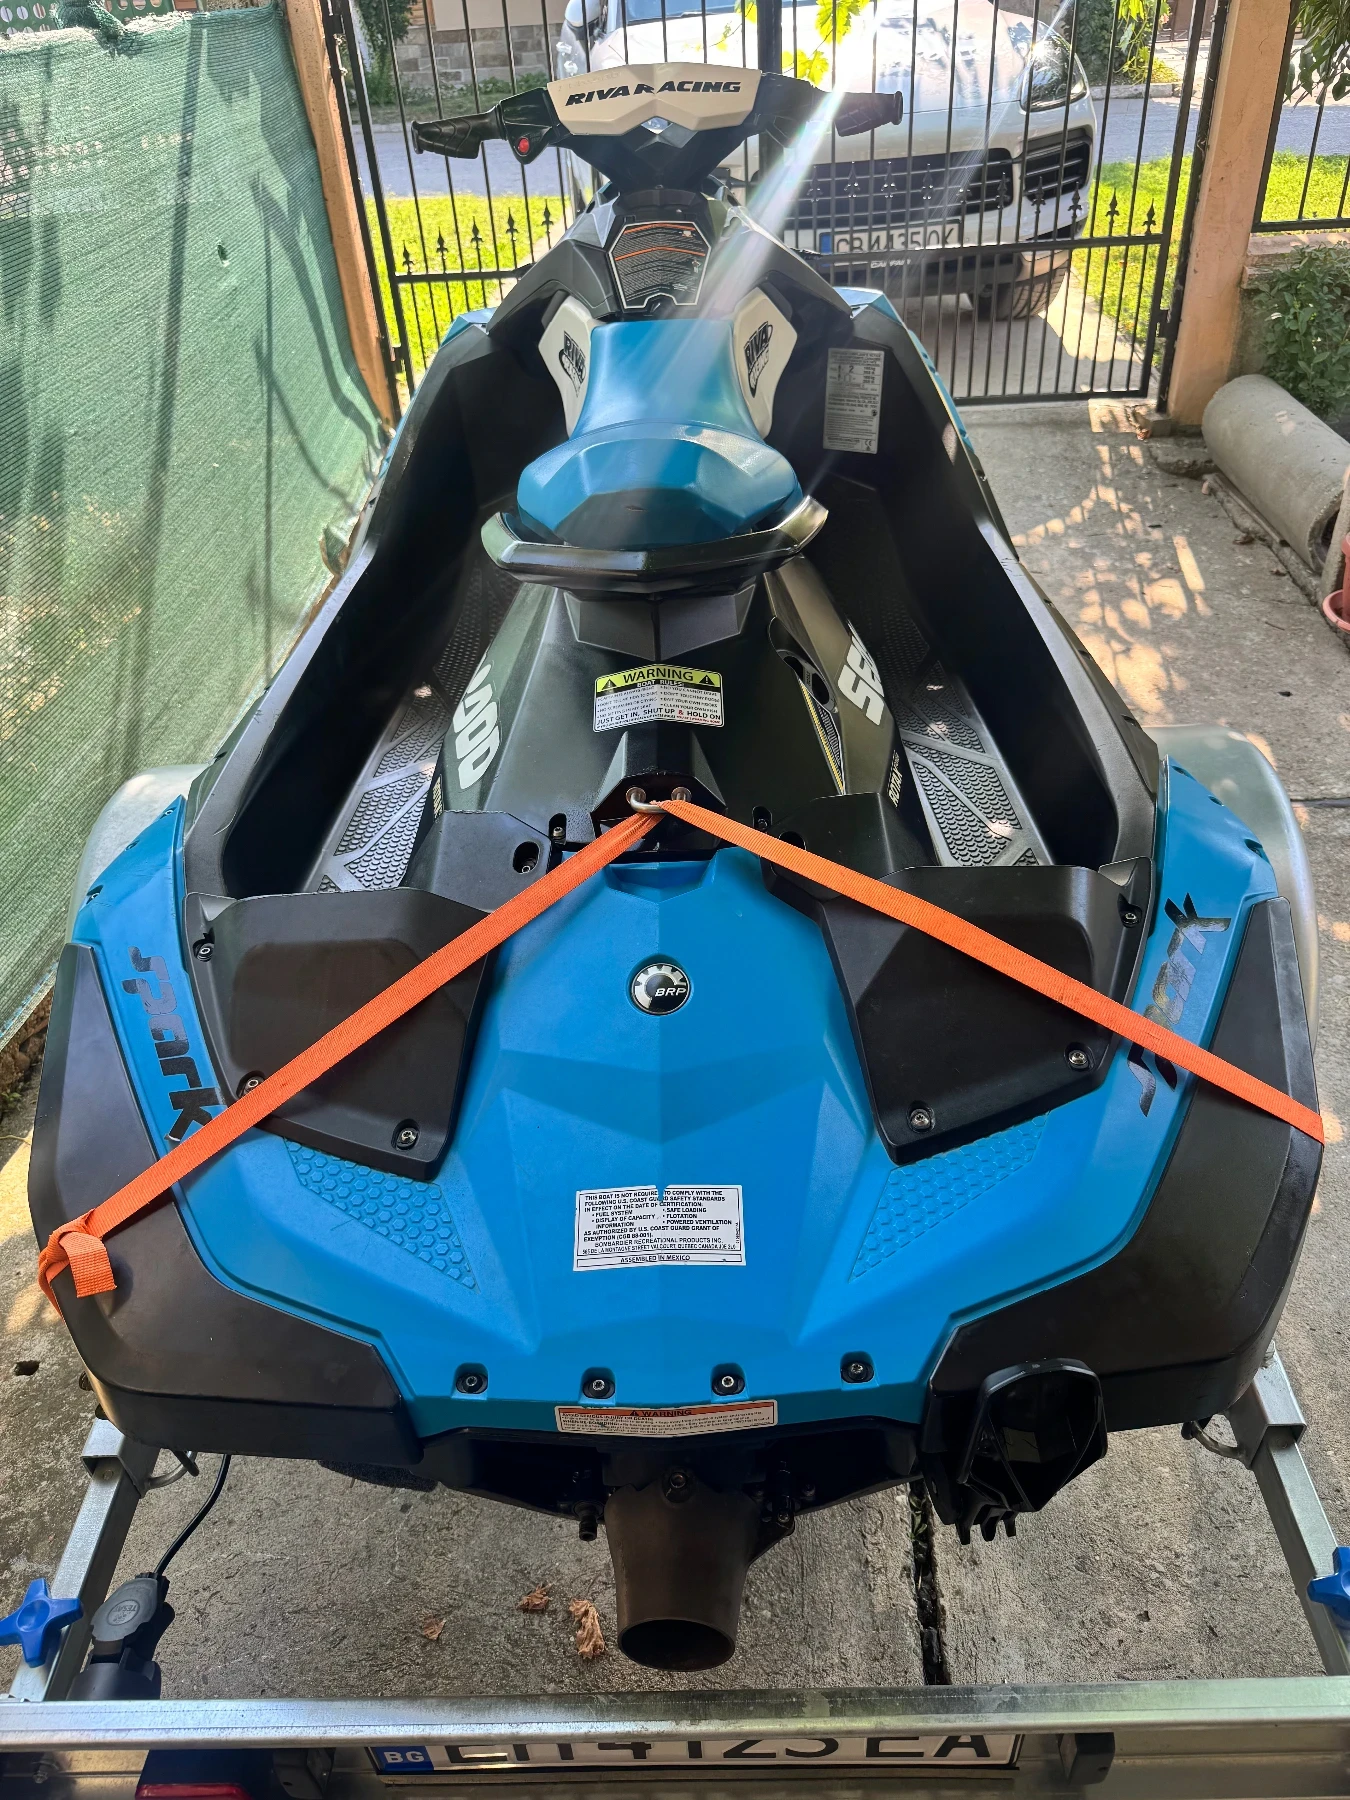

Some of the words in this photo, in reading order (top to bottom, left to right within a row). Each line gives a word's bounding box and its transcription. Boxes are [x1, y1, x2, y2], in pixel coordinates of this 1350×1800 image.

[565, 86, 630, 106] RIVA
[634, 81, 741, 95] RACING
[623, 668, 693, 683] WARNING
[637, 680, 656, 688] BOAT
[596, 716, 614, 726] JUST
[615, 713, 628, 721] GET
[655, 988, 686, 996] BRP
[595, 1240, 632, 1248] BOMBARDIER
[620, 1255, 657, 1263] ASSEMBLED
[642, 1409, 692, 1417] WARNING
[383, 1751, 424, 1763] BG
